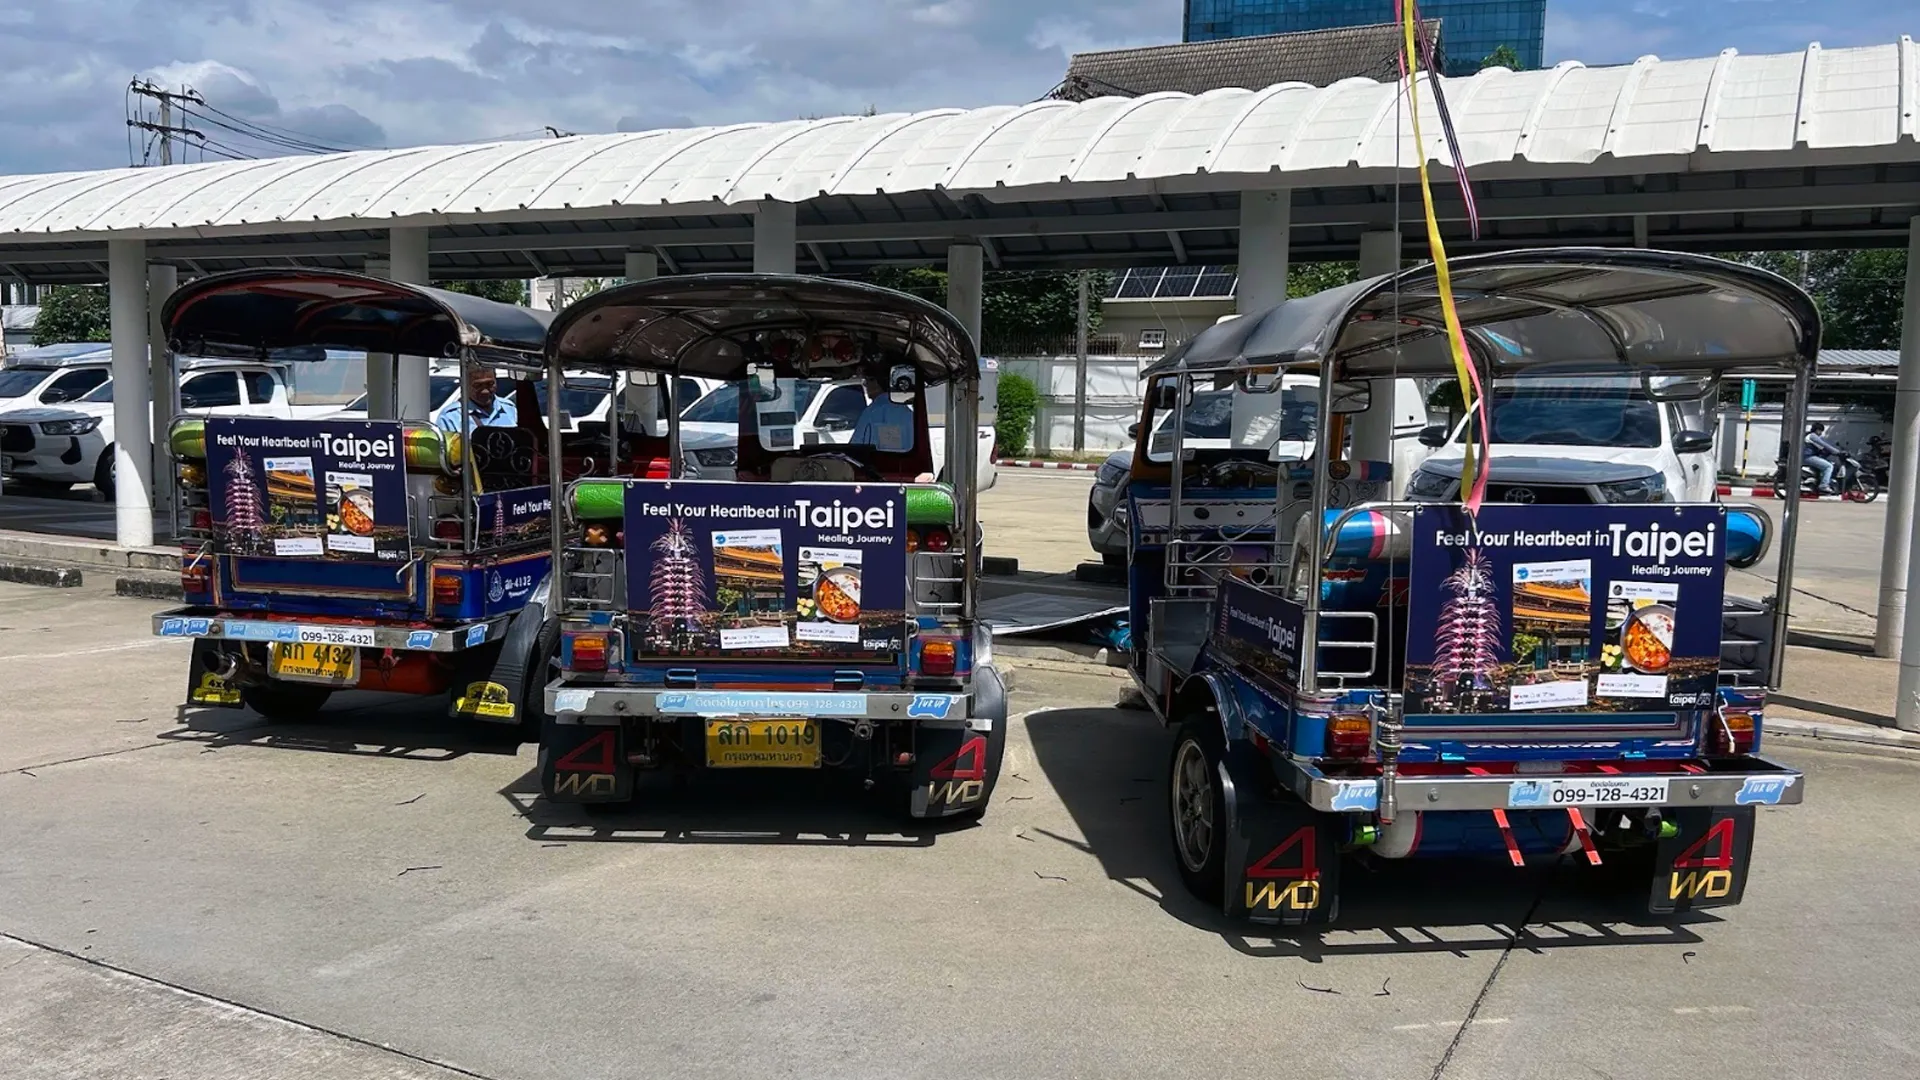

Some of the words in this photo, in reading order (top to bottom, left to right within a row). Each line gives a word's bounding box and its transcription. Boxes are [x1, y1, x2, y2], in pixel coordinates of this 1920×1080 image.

[217, 434, 236, 446] Feel
[237, 435, 260, 447] Your
[262, 436, 310, 448] Heartbeat
[312, 437, 323, 449] in
[320, 433, 395, 462] Taipei
[338, 461, 365, 471] Healing
[367, 462, 395, 471] Journey
[513, 502, 527, 516] Feel
[528, 501, 543, 513] Your
[642, 503, 672, 517] Feel
[674, 504, 707, 518] Your
[710, 504, 780, 519] Heartbeat
[783, 505, 797, 519] in
[795, 499, 895, 534] Taipei
[818, 534, 854, 545] Healing
[856, 534, 894, 545] Journey
[1435, 530, 1469, 547] Feel
[1473, 530, 1510, 547] Your
[1513, 530, 1592, 547] Heartbeat
[1595, 529, 1610, 547] in
[1608, 522, 1716, 565] Taipei
[1632, 565, 1671, 577] Healing
[1672, 565, 1713, 577] Journey
[301, 630, 373, 645] 099-128-4321
[863, 639, 888, 650] taipei
[1267, 616, 1297, 650] Taipei
[313, 644, 352, 665] 4132
[1669, 693, 1697, 706] taipei
[718, 723, 750, 746] สก
[764, 725, 815, 746] 1019
[554, 730, 617, 774] 4
[724, 751, 803, 764] กรุงเทพมหานคร
[930, 736, 988, 781] 4
[1552, 787, 1665, 803] 099-128-4321
[1246, 825, 1320, 880] 4
[1673, 818, 1735, 870] 4
[1246, 880, 1320, 910] WD
[1669, 870, 1733, 900] WD
